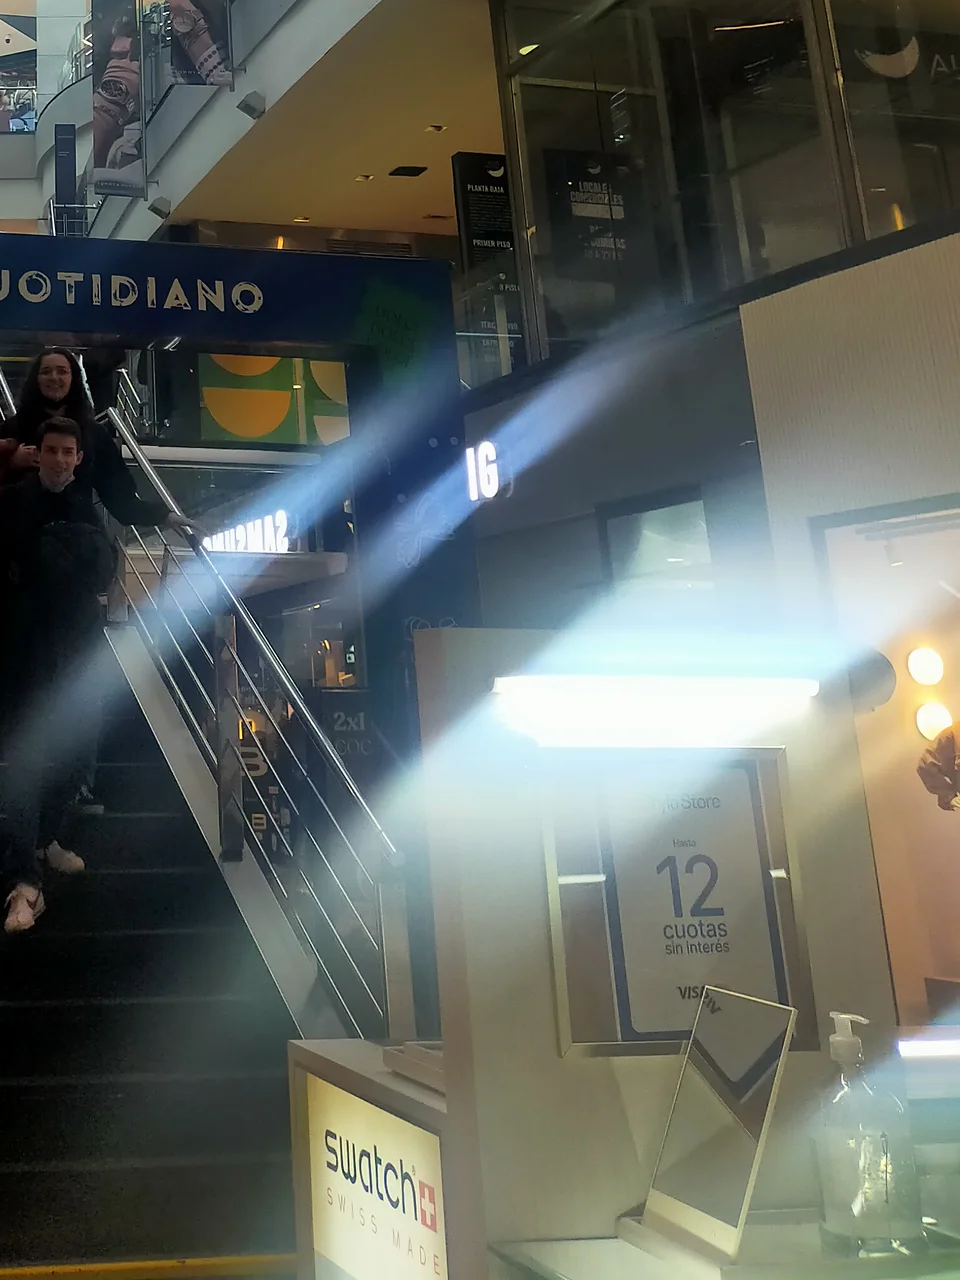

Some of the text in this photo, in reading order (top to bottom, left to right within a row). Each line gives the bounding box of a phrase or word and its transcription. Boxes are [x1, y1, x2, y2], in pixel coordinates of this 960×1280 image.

[333, 711, 366, 731] 2x1
[681, 792, 721, 809] Store
[672, 838, 696, 848] Hasta
[656, 853, 725, 918] 12
[663, 919, 728, 939] cuotas
[665, 939, 730, 955] sin interés
[325, 1128, 418, 1222] swatch
[326, 1186, 440, 1276] SWISS MADE
